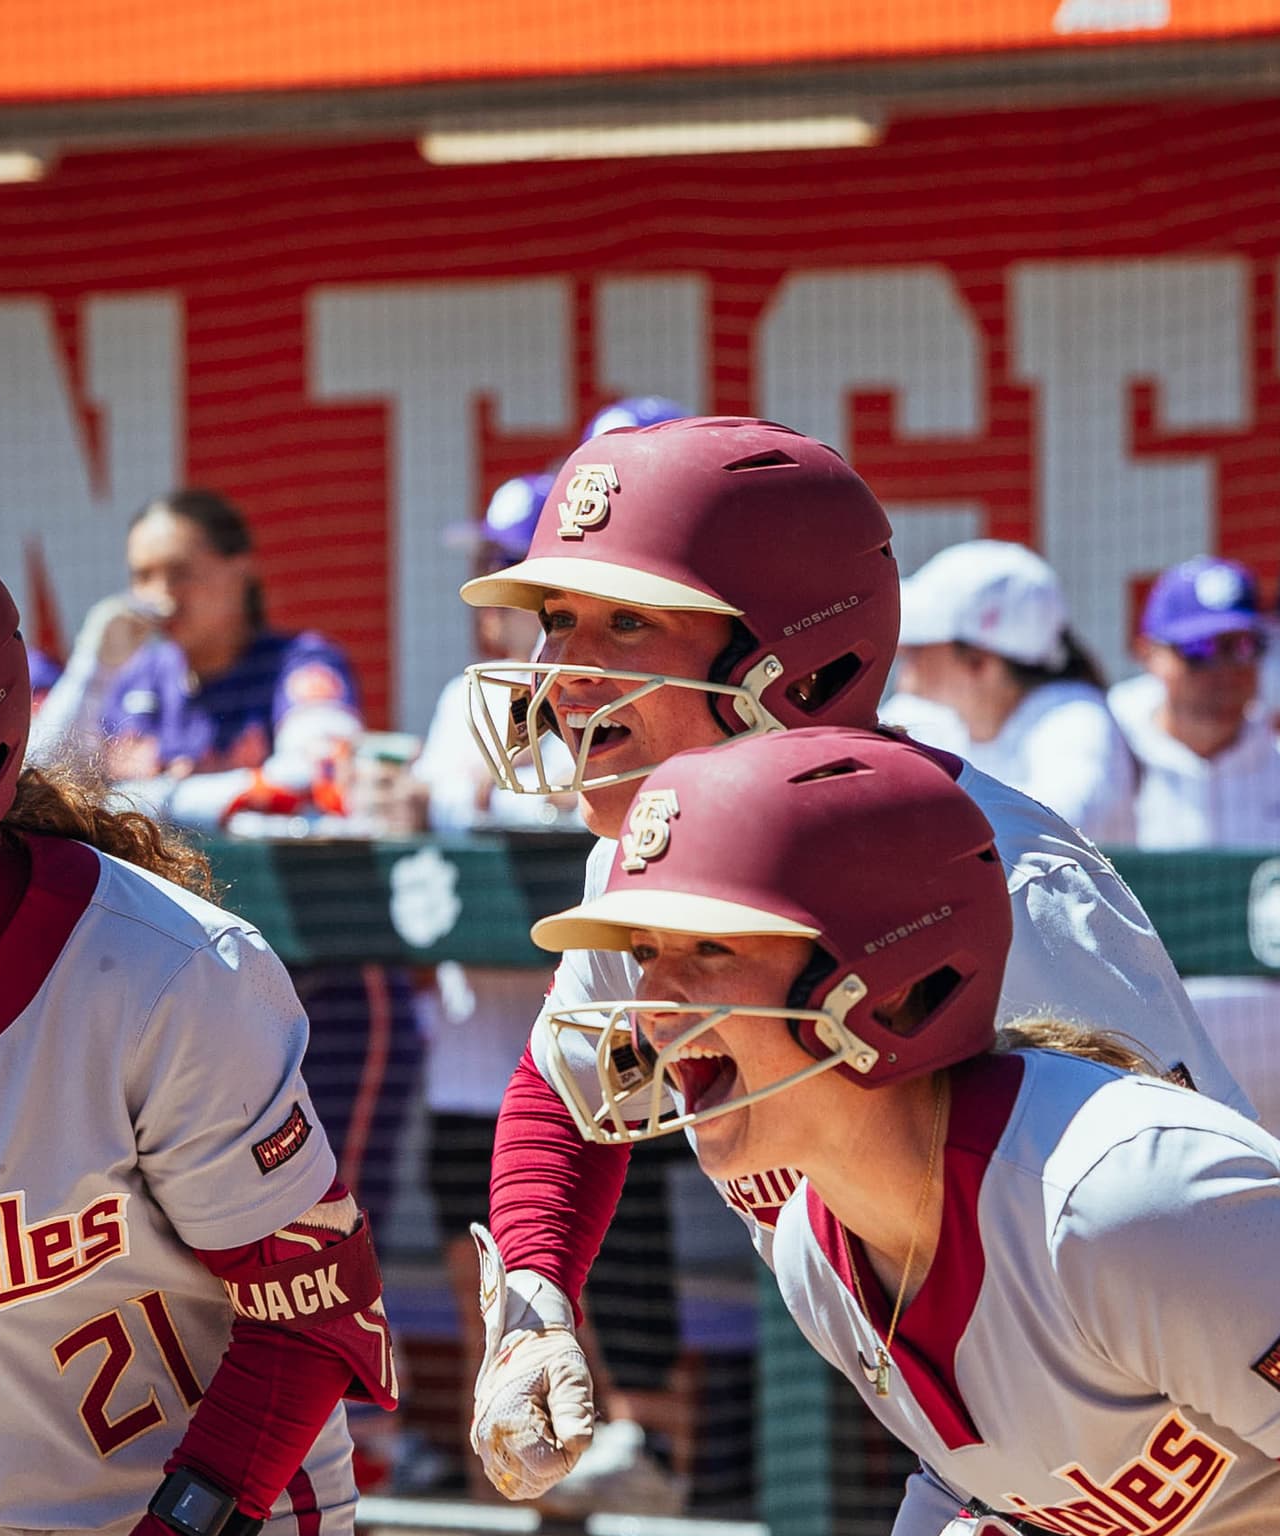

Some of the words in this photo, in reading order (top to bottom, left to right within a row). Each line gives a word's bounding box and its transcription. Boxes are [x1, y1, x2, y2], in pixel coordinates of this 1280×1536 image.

[783, 595, 859, 637] EVOSHIELD
[864, 905, 953, 955] EVOSHIELD
[52, 1288, 206, 1461] 21
